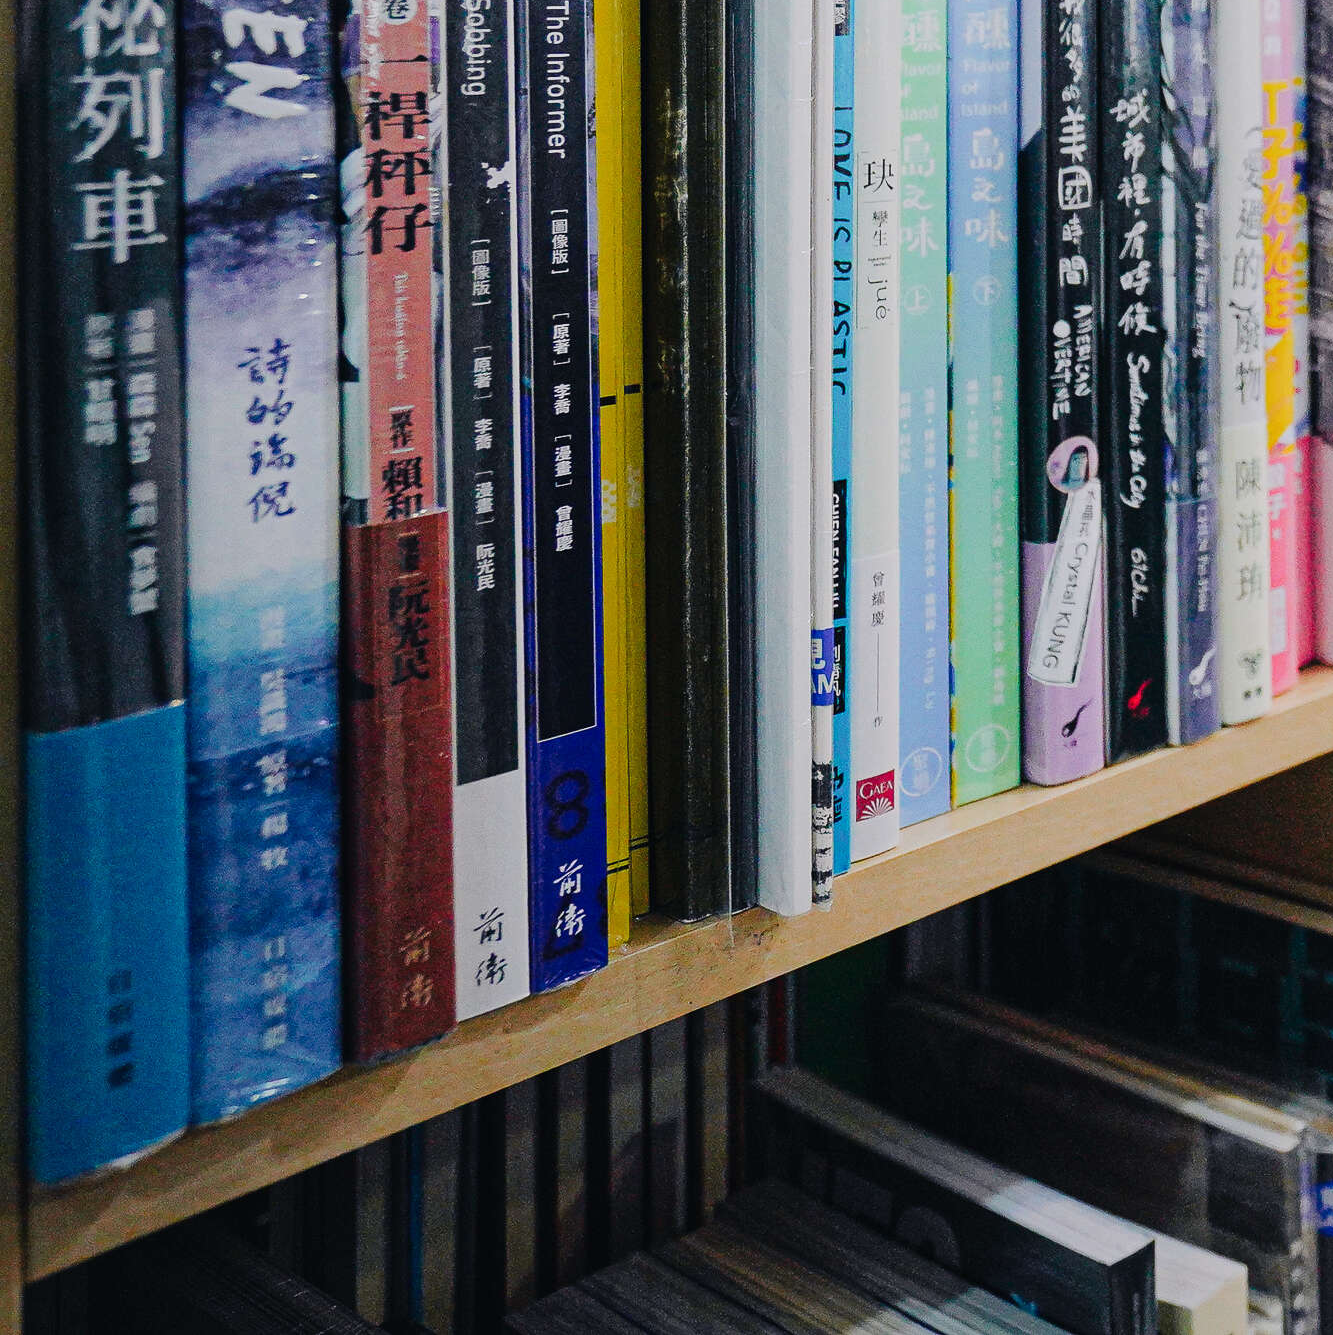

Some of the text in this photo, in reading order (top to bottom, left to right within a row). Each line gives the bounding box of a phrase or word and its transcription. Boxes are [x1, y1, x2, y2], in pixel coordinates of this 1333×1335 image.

[546, 0, 571, 159] The Informer
[863, 158, 894, 194] 玦
[964, 127, 1009, 248] 島之味
[1073, 304, 1095, 398] AMERICAN
[555, 505, 573, 552] 曾耀慶
[476, 543, 495, 591] 阮光民
[1066, 541, 1090, 611] Crystal
[1042, 611, 1073, 670] KUNG
[859, 778, 894, 801] GAEA
[553, 858, 587, 938] 前衛
[473, 907, 508, 986] 前衛
